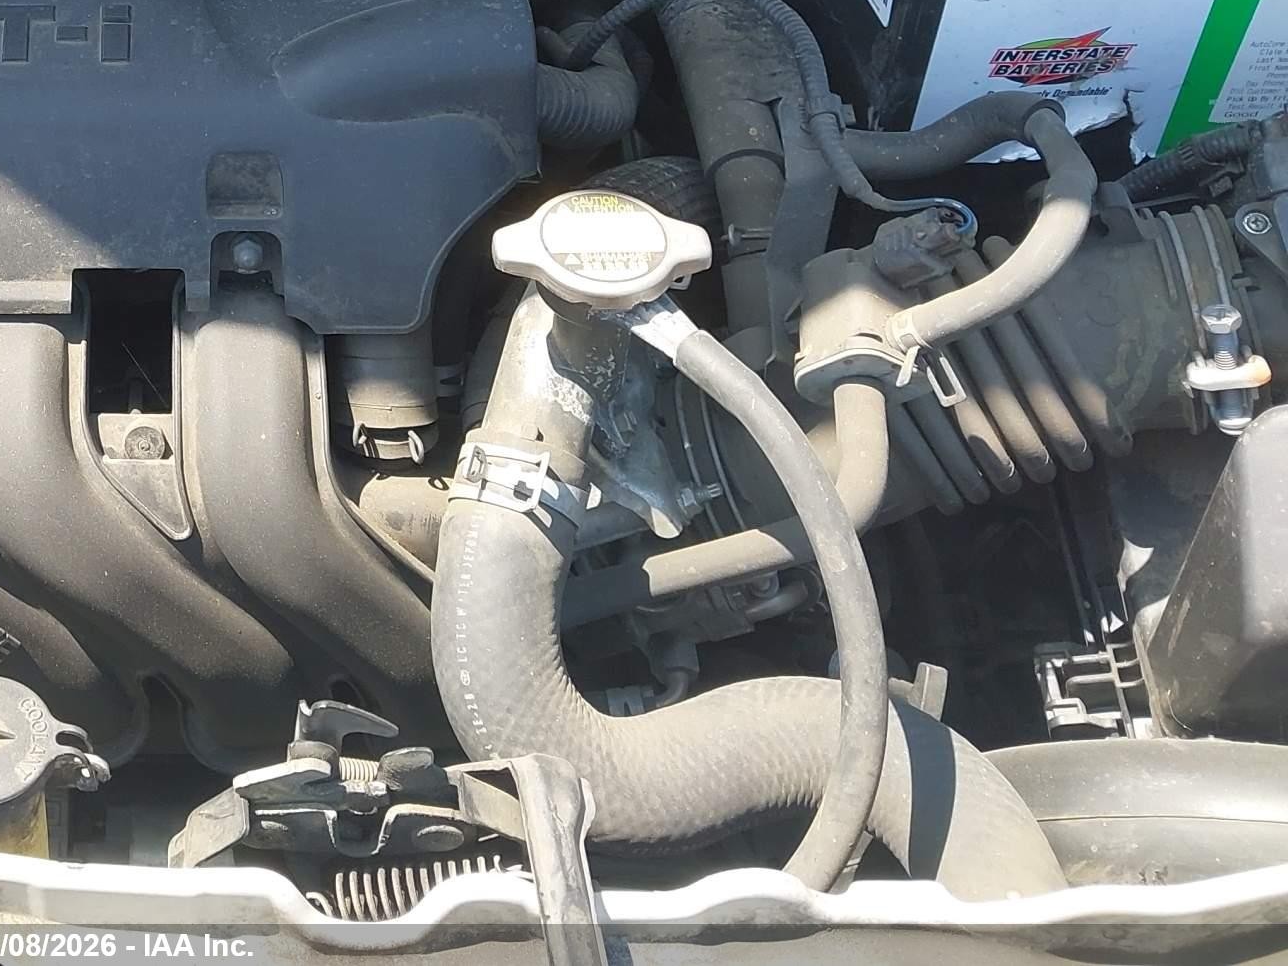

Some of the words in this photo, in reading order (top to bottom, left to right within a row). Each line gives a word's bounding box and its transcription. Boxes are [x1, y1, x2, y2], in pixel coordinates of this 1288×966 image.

[994, 46, 1130, 62] INTERSTATE
[994, 62, 1114, 76] BATTERIES
[571, 196, 618, 205] CAUTION
[574, 204, 634, 214] ATTENTION
[15, 698, 49, 782] COOLANT
